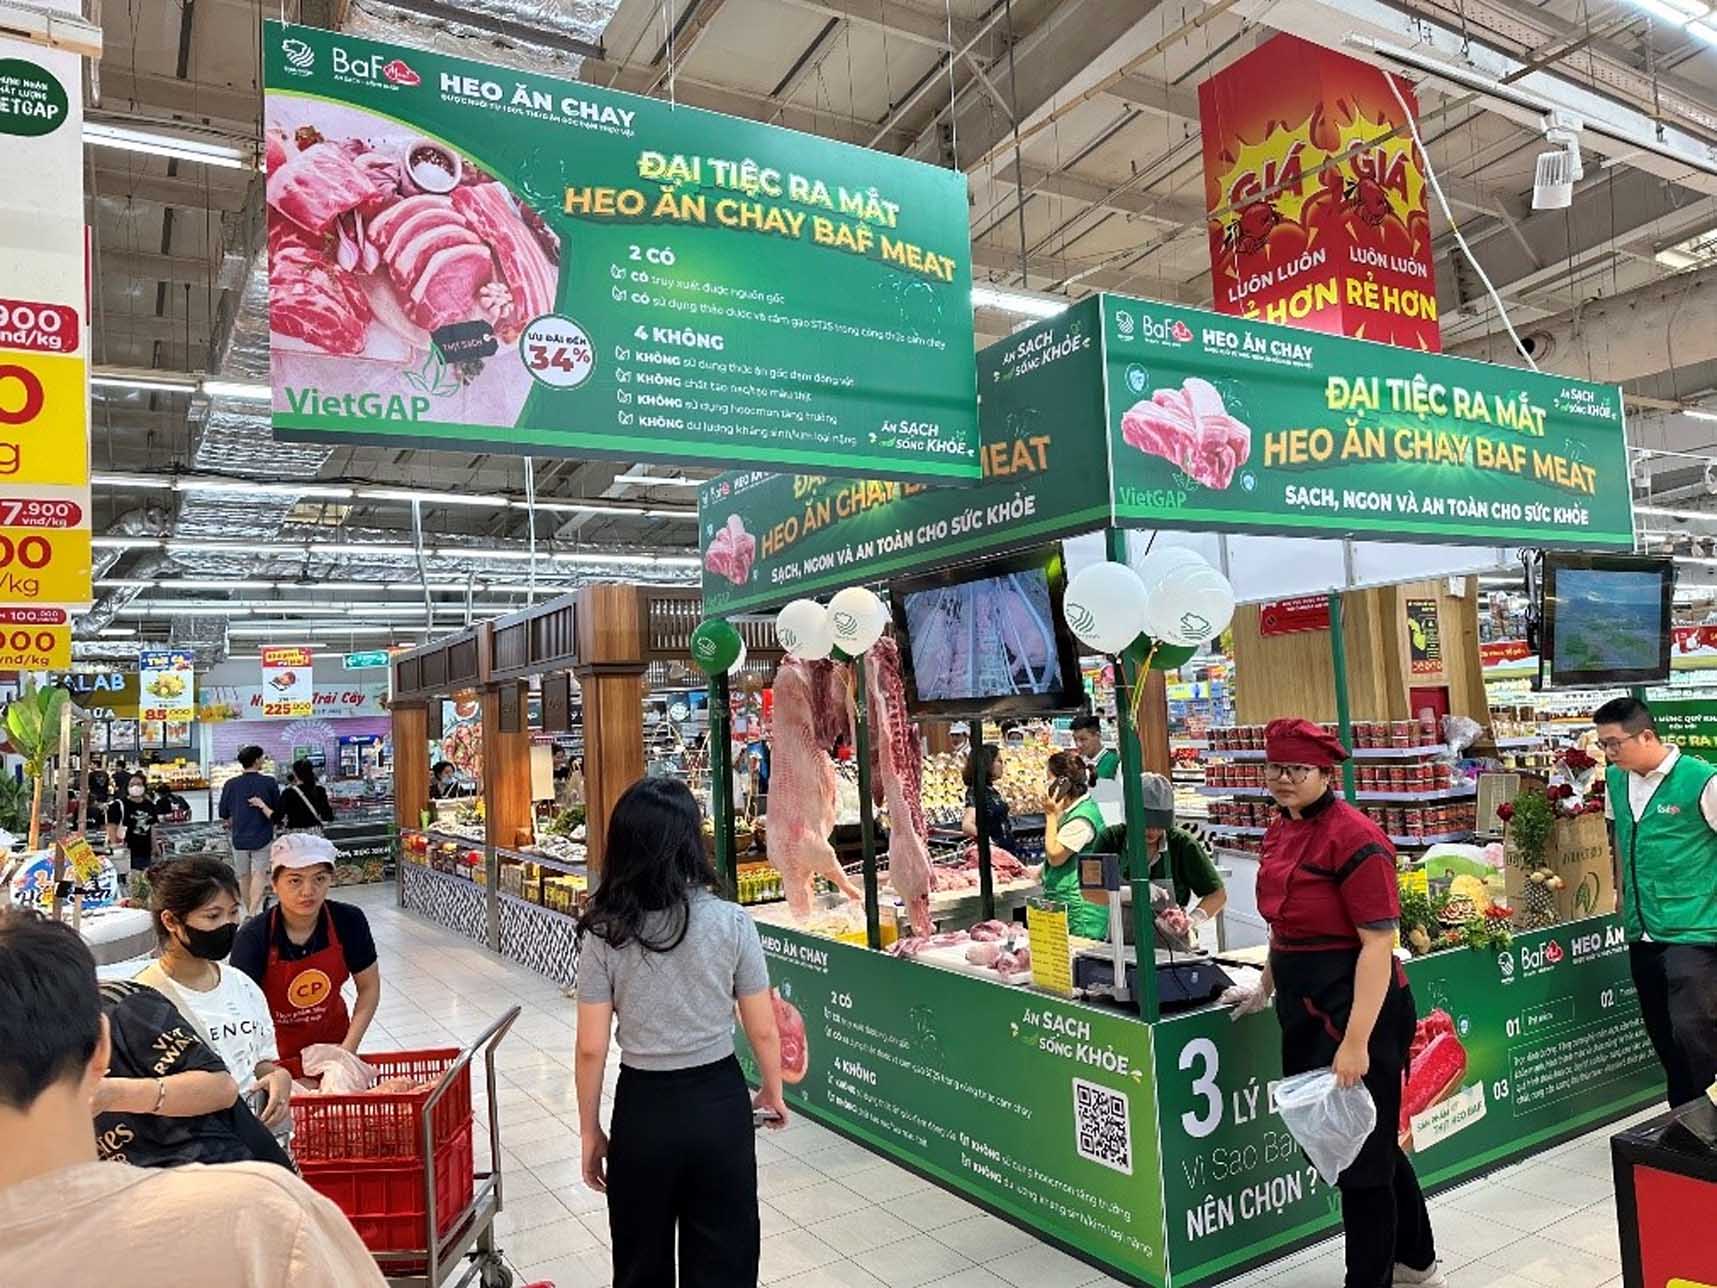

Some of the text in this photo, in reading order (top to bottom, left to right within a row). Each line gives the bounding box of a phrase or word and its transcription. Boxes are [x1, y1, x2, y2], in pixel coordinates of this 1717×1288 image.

[332, 47, 385, 79] BaF
[440, 72, 504, 101] HEO
[510, 82, 553, 112] ĂN
[560, 98, 636, 128] CHAY
[1229, 140, 1306, 206] GIÁ
[1349, 138, 1410, 203] GIÁ
[638, 150, 901, 230] ĐẠI TIỆC RA MẮT
[563, 183, 957, 283] HEO ĂN CHAY BAF MEAT
[629, 245, 676, 266] 2 CÓ
[1349, 246, 1428, 279] LUÔN LUÔN
[631, 270, 649, 283] CÓ
[1227, 246, 1327, 304] LUÔN LUÔN
[631, 291, 650, 305] CÓ
[1264, 276, 1339, 325] HƠN
[1345, 271, 1438, 322] RẺ HƠN
[0, 330, 62, 350] nd/kg
[634, 325, 725, 351] 4 KHÔNG
[1017, 328, 1054, 358] SẠCH
[1202, 328, 1239, 349] HEO
[1243, 330, 1267, 353] ĂN
[1270, 340, 1313, 361] CHAY
[529, 344, 591, 373] 34%
[635, 350, 682, 367] KHÔNG
[636, 371, 682, 388] KHÔNG
[284, 386, 431, 422] VietGAP
[637, 393, 683, 409] KHÔNG
[1325, 373, 1547, 438] ĐẠI TIỆC RA MẮT
[638, 415, 684, 430] KHÔNG
[899, 420, 940, 438] SẠCH
[926, 436, 967, 454] KHỎE
[1263, 417, 1597, 496] HEO ĂN CHAY BAF MEAT
[1119, 486, 1187, 509] VietGAP
[1285, 485, 1590, 526] SẠCH, NGON VÀ AN TOÀN CHO SỨC KHỎE
[760, 517, 798, 560] HEO
[802, 497, 832, 536] ĂN
[803, 551, 835, 576] NGON
[836, 546, 854, 565] VÀ
[855, 543, 875, 561] AN
[876, 528, 914, 557] TOÀN
[916, 519, 948, 544] CHO
[950, 505, 984, 537] SỨC
[987, 492, 1036, 526] KHỎE
[0, 630, 56, 652] 00
[1571, 933, 1602, 957] HEO
[1604, 924, 1625, 948] ĂN
[799, 947, 829, 967] CHAY
[297, 981, 324, 998] CP
[1600, 988, 1615, 1009] 02
[1042, 1010, 1091, 1041] SẠCH
[1505, 1016, 1521, 1038] 01
[1040, 1035, 1130, 1076] SỐNG KHỎE
[842, 1059, 877, 1086] KHÔNG
[1178, 1037, 1224, 1139] 3
[1232, 1075, 1260, 1126] LÝ
[1492, 1079, 1510, 1100] 03
[1182, 1153, 1206, 1190] Vì
[1211, 1144, 1259, 1181] Sao
[1186, 1194, 1235, 1242] NÊN
[1239, 1170, 1303, 1221] CHỌN
[1305, 1165, 1319, 1196] ?
